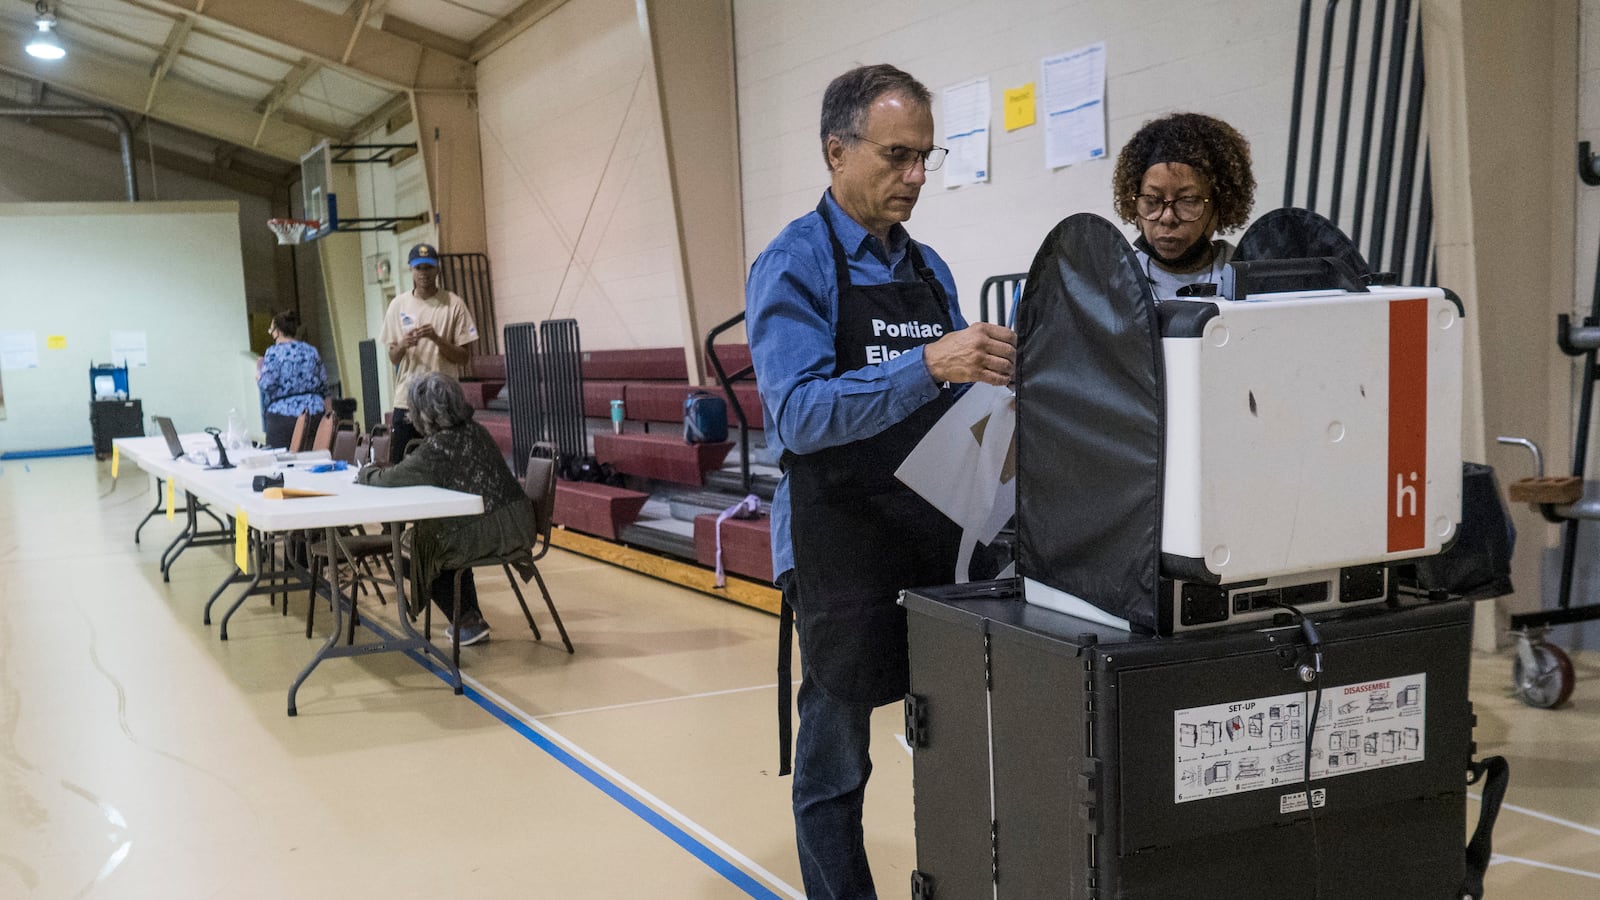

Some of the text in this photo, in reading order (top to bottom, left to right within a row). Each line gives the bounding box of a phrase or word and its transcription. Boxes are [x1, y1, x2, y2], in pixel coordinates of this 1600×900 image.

[871, 319, 943, 338] Pontiac
[1344, 681, 1391, 695] DISASSEMBLE
[1228, 702, 1256, 713] SET-UP
